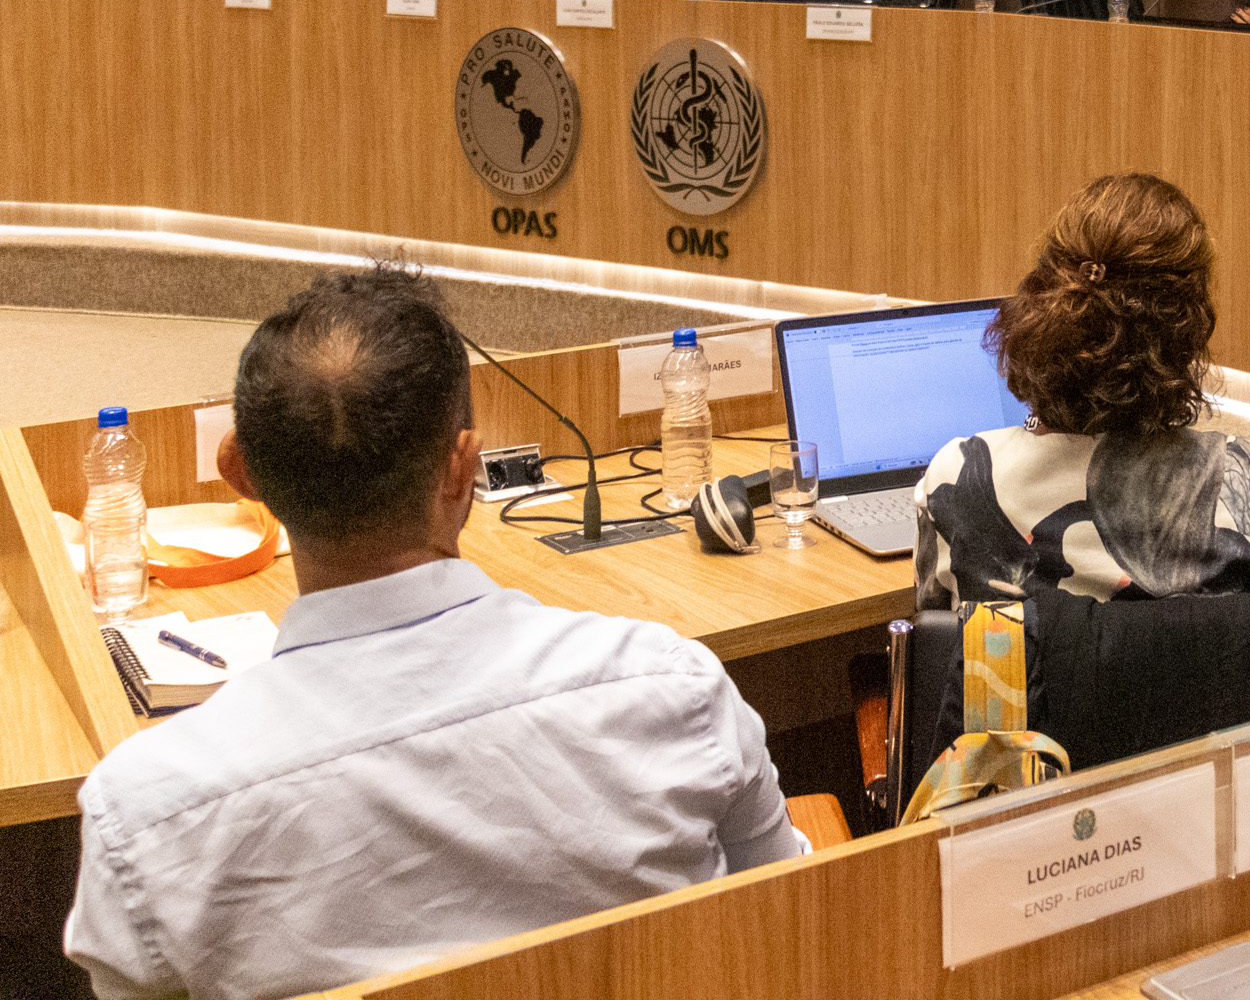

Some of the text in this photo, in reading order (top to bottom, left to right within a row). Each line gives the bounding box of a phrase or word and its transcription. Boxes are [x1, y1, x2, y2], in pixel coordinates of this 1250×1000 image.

[461, 32, 555, 86] PRO SALUTE
[481, 149, 565, 190] NOVI MUNDI
[491, 207, 557, 239] OPAS
[666, 225, 729, 259] OMS
[1027, 835, 1142, 885] LUCIANA DIAS
[1024, 893, 1063, 919] ENSP
[1076, 866, 1144, 903] Fiocruz/RJ
